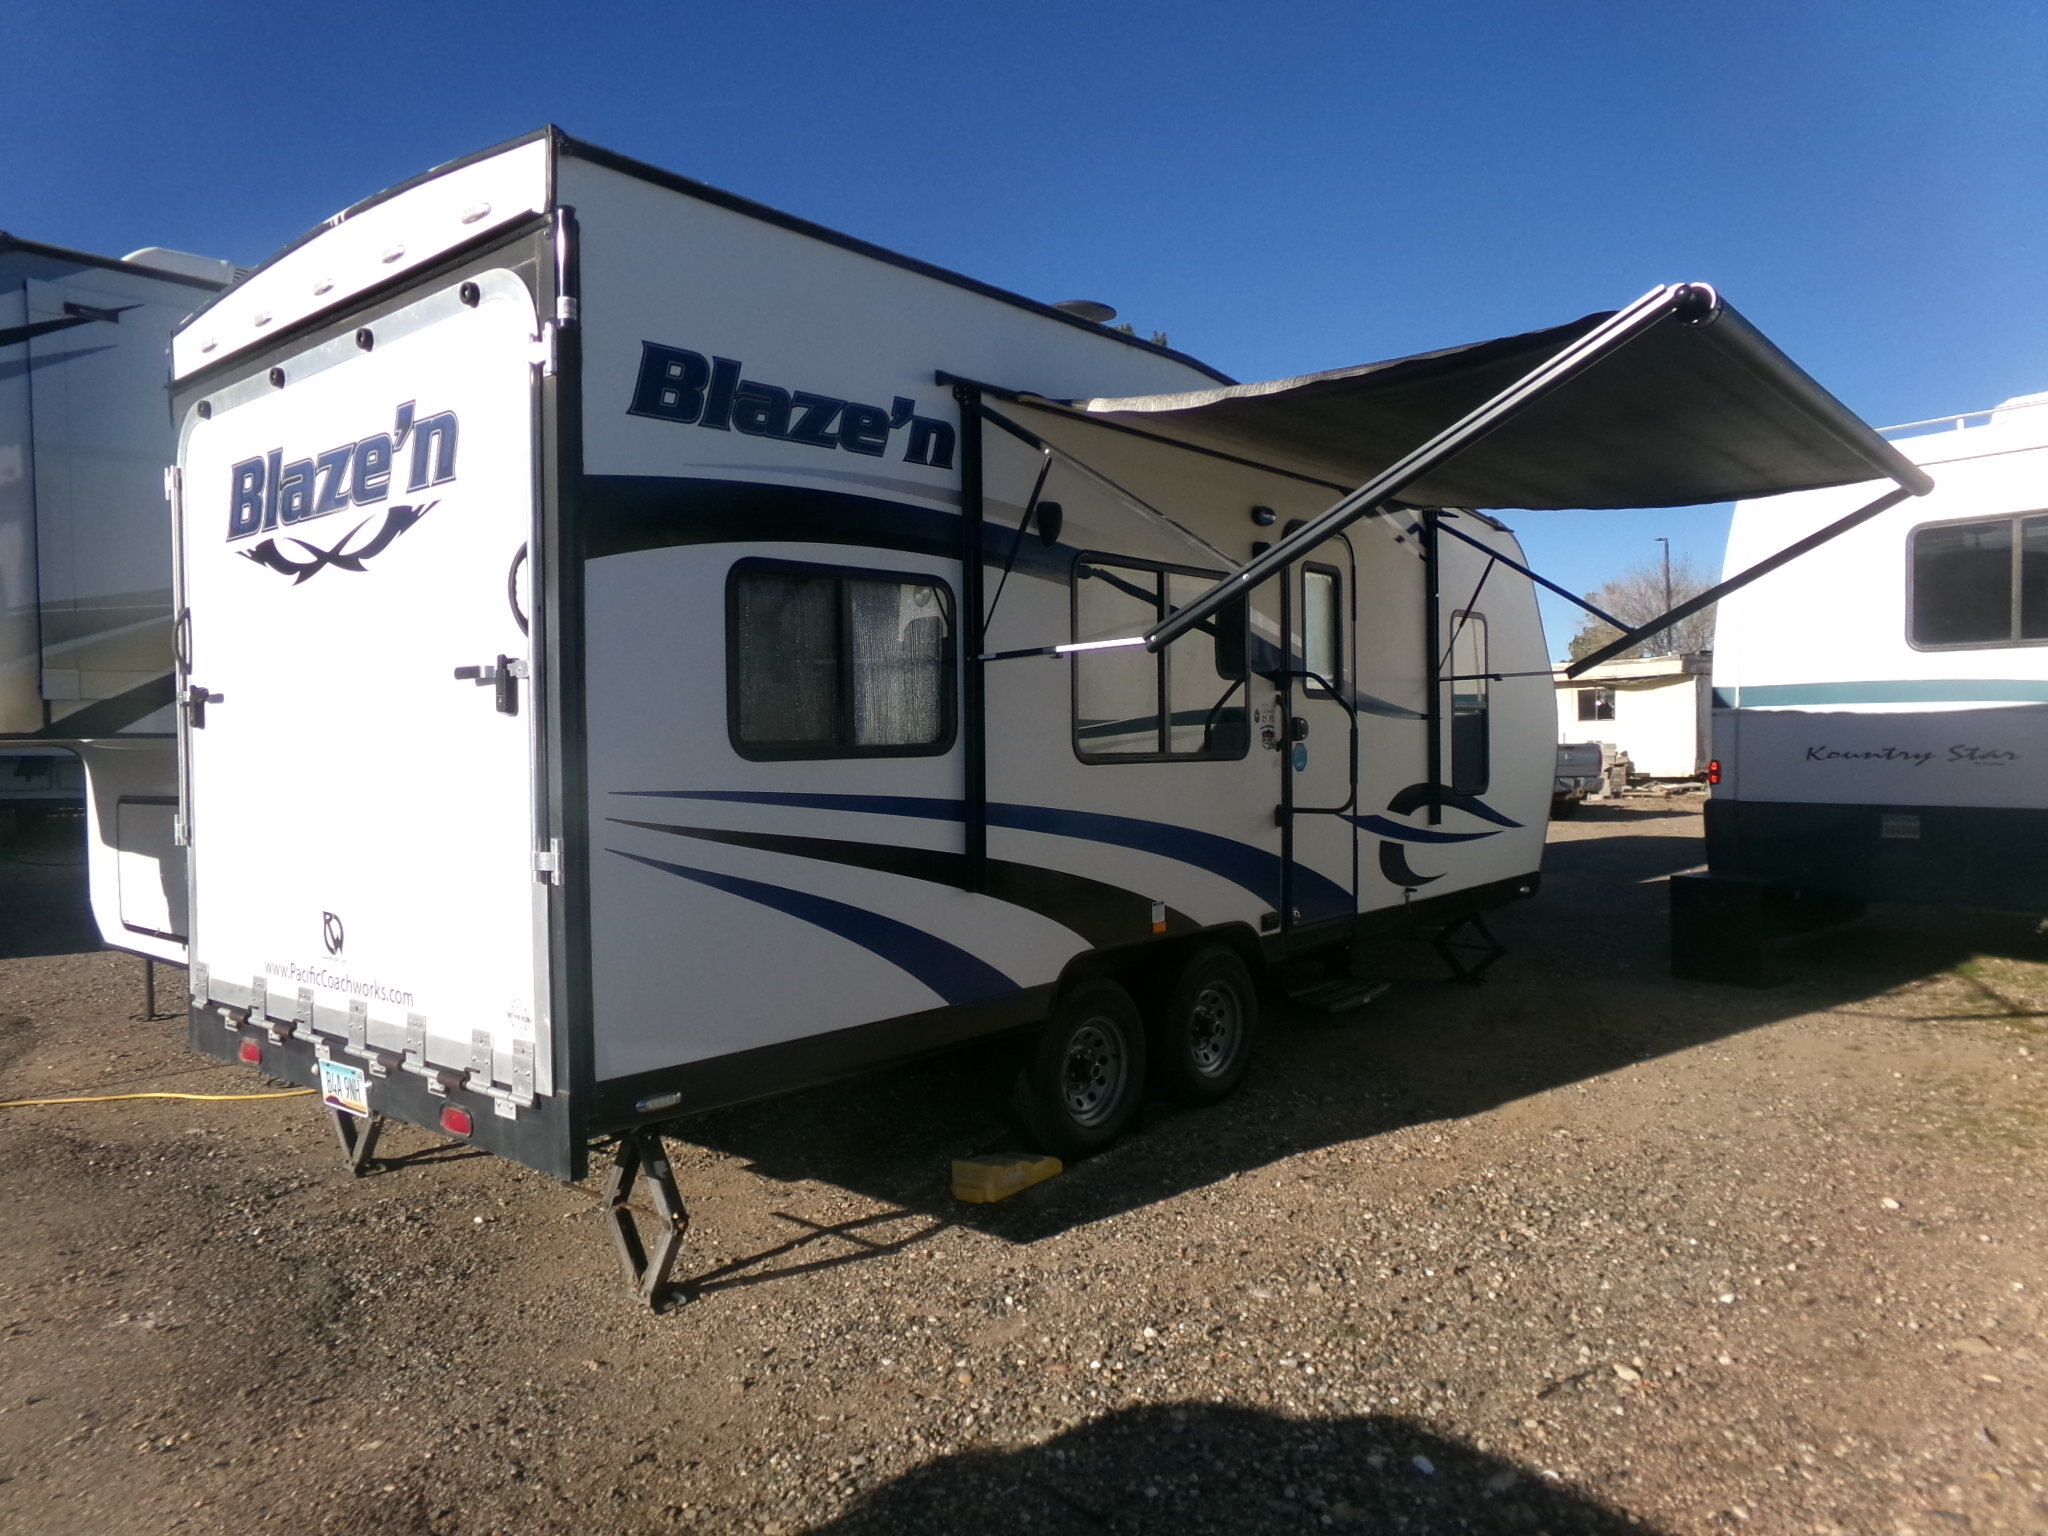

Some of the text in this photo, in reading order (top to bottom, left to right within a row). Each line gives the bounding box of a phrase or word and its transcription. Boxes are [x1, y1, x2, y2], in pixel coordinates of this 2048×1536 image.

[625, 340, 956, 470] Blaze'n
[226, 399, 459, 543] Blaze'n
[1806, 744, 2020, 767] Kountry Star
[264, 961, 414, 1007] www.PacificCoachworks.com
